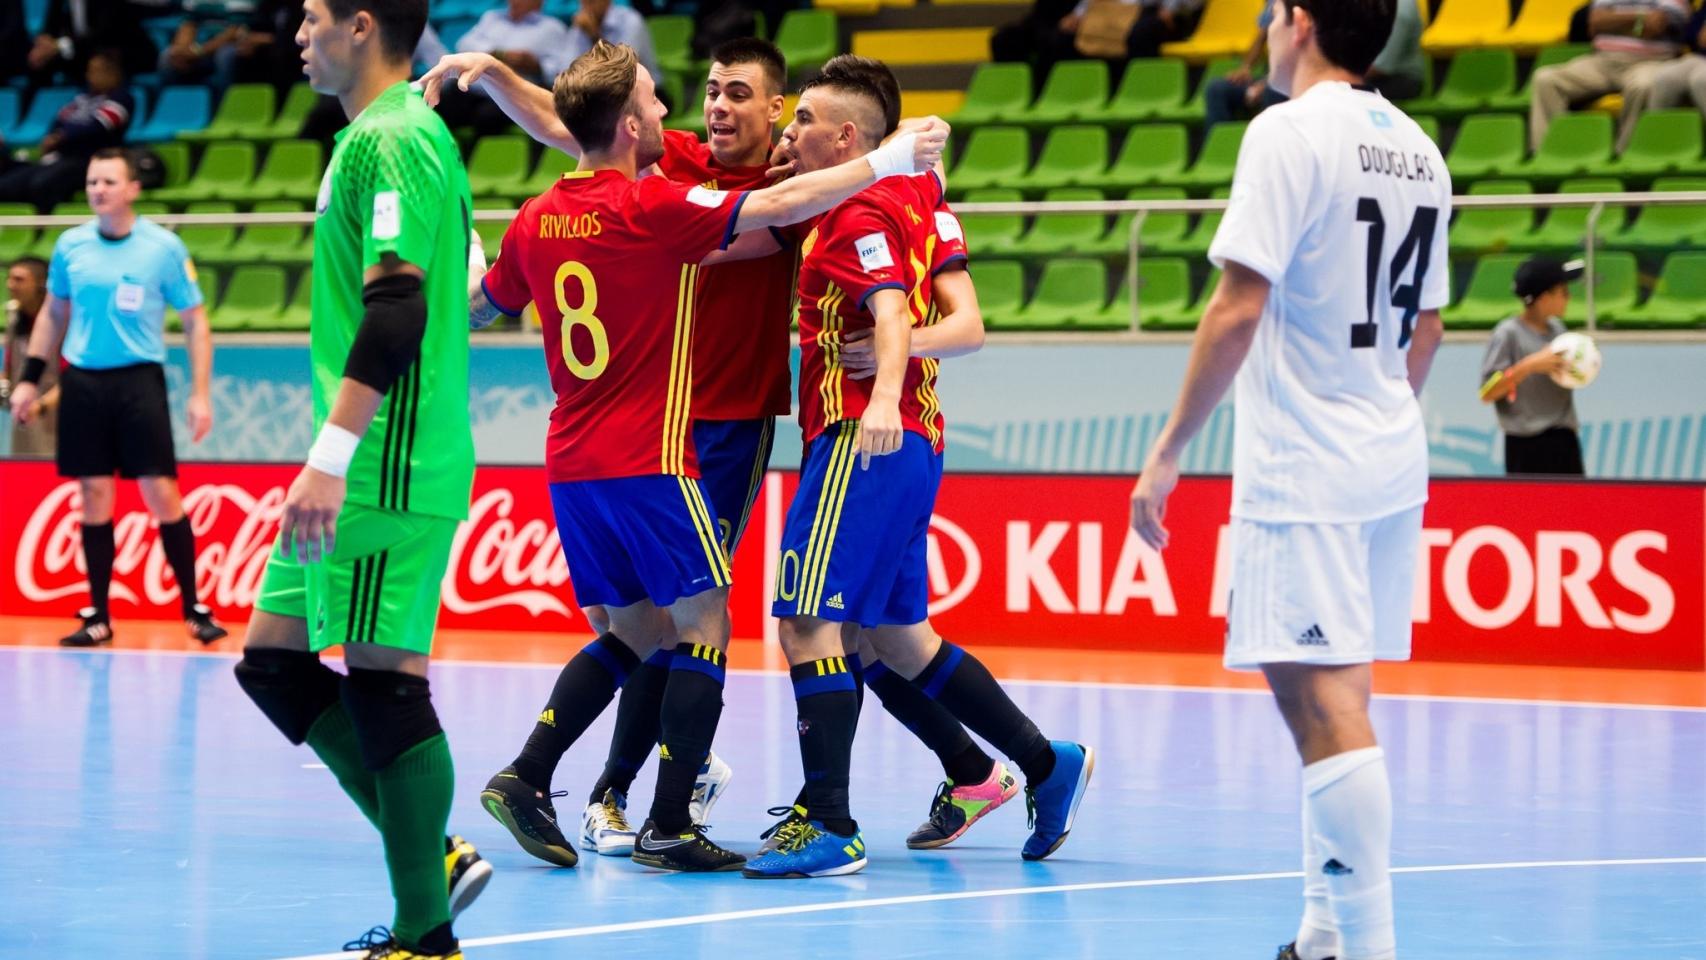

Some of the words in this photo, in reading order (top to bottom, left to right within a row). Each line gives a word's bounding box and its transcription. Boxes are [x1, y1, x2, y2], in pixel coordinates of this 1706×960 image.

[1359, 144, 1434, 181] DOUGLAS
[554, 260, 610, 380] 8
[1350, 197, 1439, 349] 14
[1005, 521, 1178, 617] KIA
[1209, 523, 1676, 634] TORS
